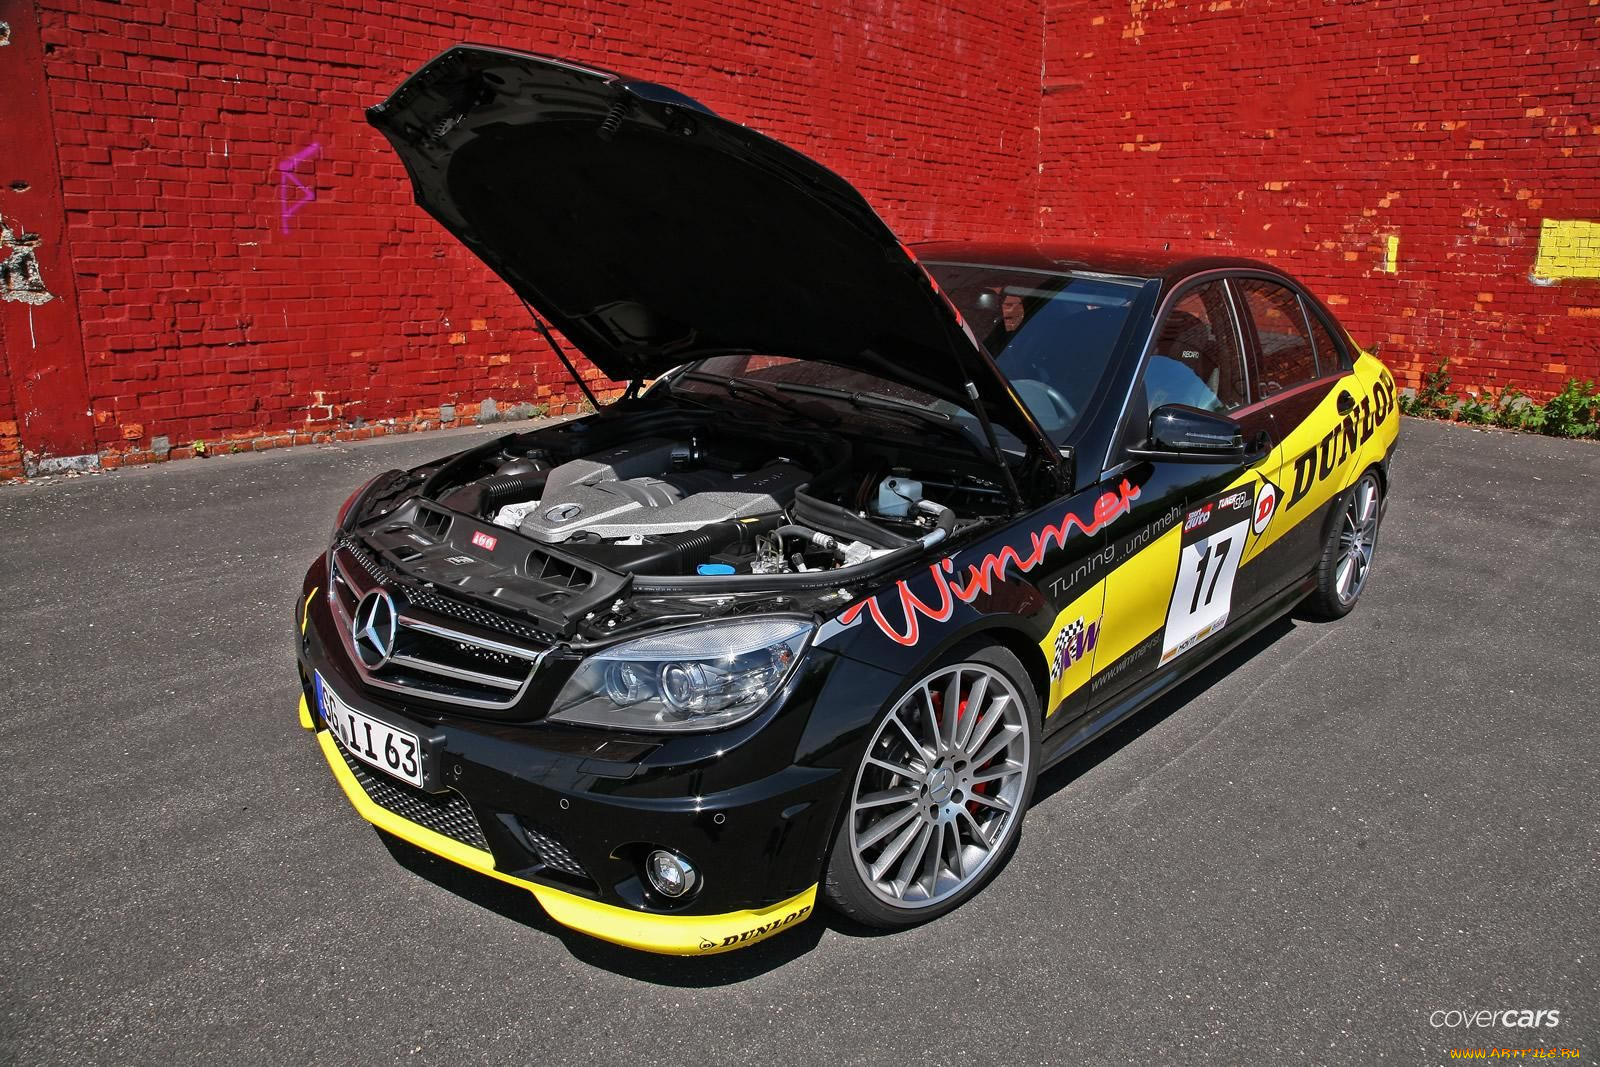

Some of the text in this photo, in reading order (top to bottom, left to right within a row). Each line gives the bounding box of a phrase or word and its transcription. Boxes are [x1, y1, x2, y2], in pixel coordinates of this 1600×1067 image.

[1285, 368, 1394, 512] DUNLOP
[837, 478, 1141, 646] Wimmer
[1185, 511, 1210, 530] auto
[1190, 537, 1232, 615] 17
[322, 686, 340, 734] SG
[385, 732, 418, 778] 63
[720, 905, 811, 947] DUNLOP
